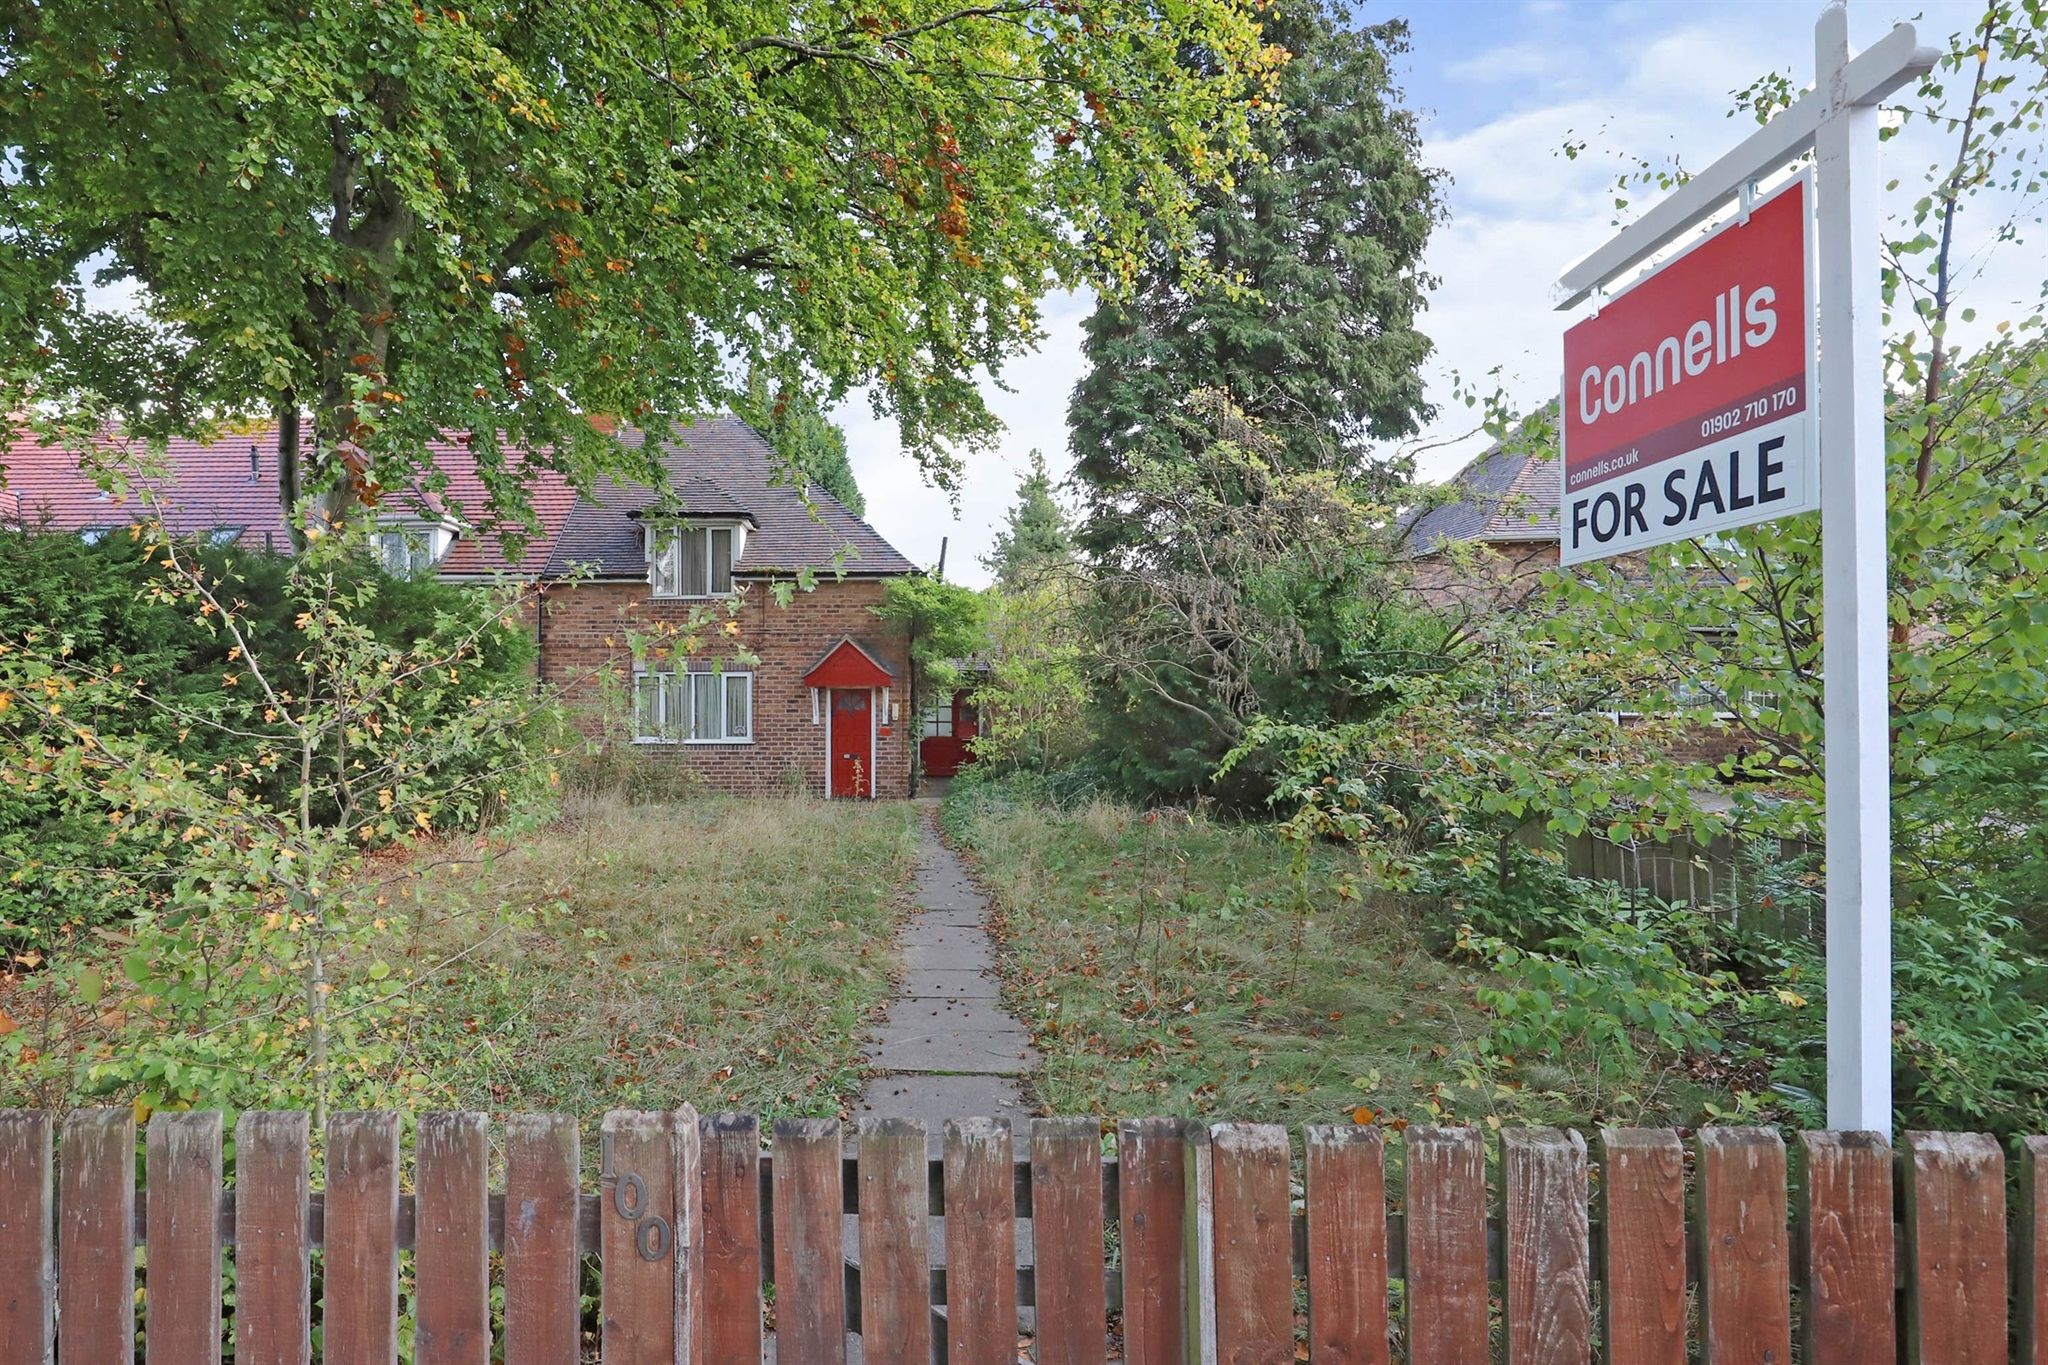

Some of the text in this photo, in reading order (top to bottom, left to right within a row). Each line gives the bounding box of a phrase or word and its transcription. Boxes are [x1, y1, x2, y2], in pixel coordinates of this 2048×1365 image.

[1580, 284, 1778, 425] Connells
[1701, 386, 1797, 438] 01902 710 170
[1570, 448, 1639, 486] connells.co.uk
[1573, 435, 1786, 549] FOR SALE
